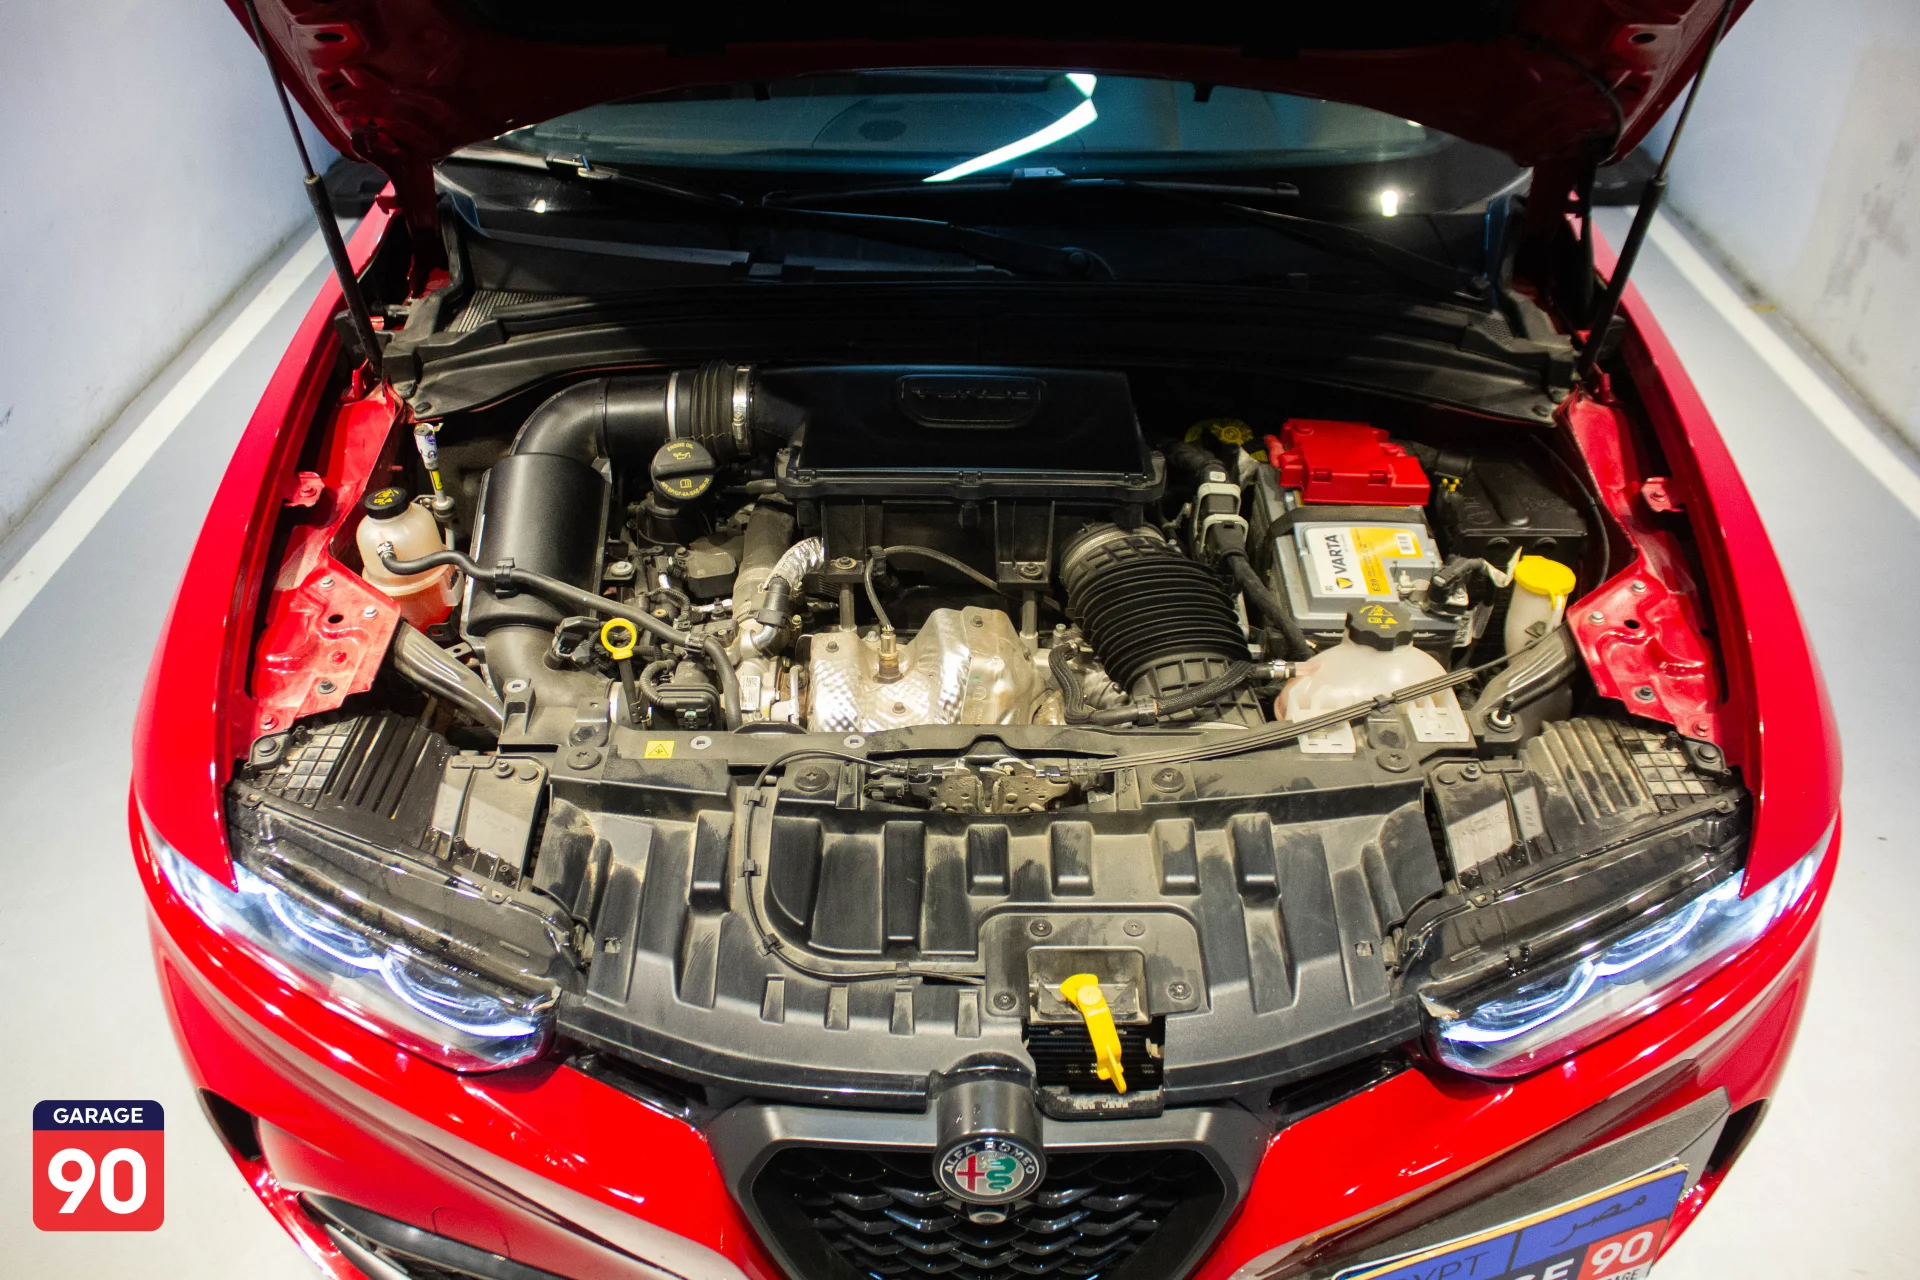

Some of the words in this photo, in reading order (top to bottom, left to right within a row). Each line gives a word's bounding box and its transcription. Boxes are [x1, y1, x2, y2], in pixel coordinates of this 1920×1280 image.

[1325, 534, 1348, 574] VARTA
[944, 1145, 976, 1174] ALFA
[984, 1141, 1035, 1174] ROMEO
[1549, 1194, 1648, 1248] مصر
[1591, 1231, 1654, 1276] 90
